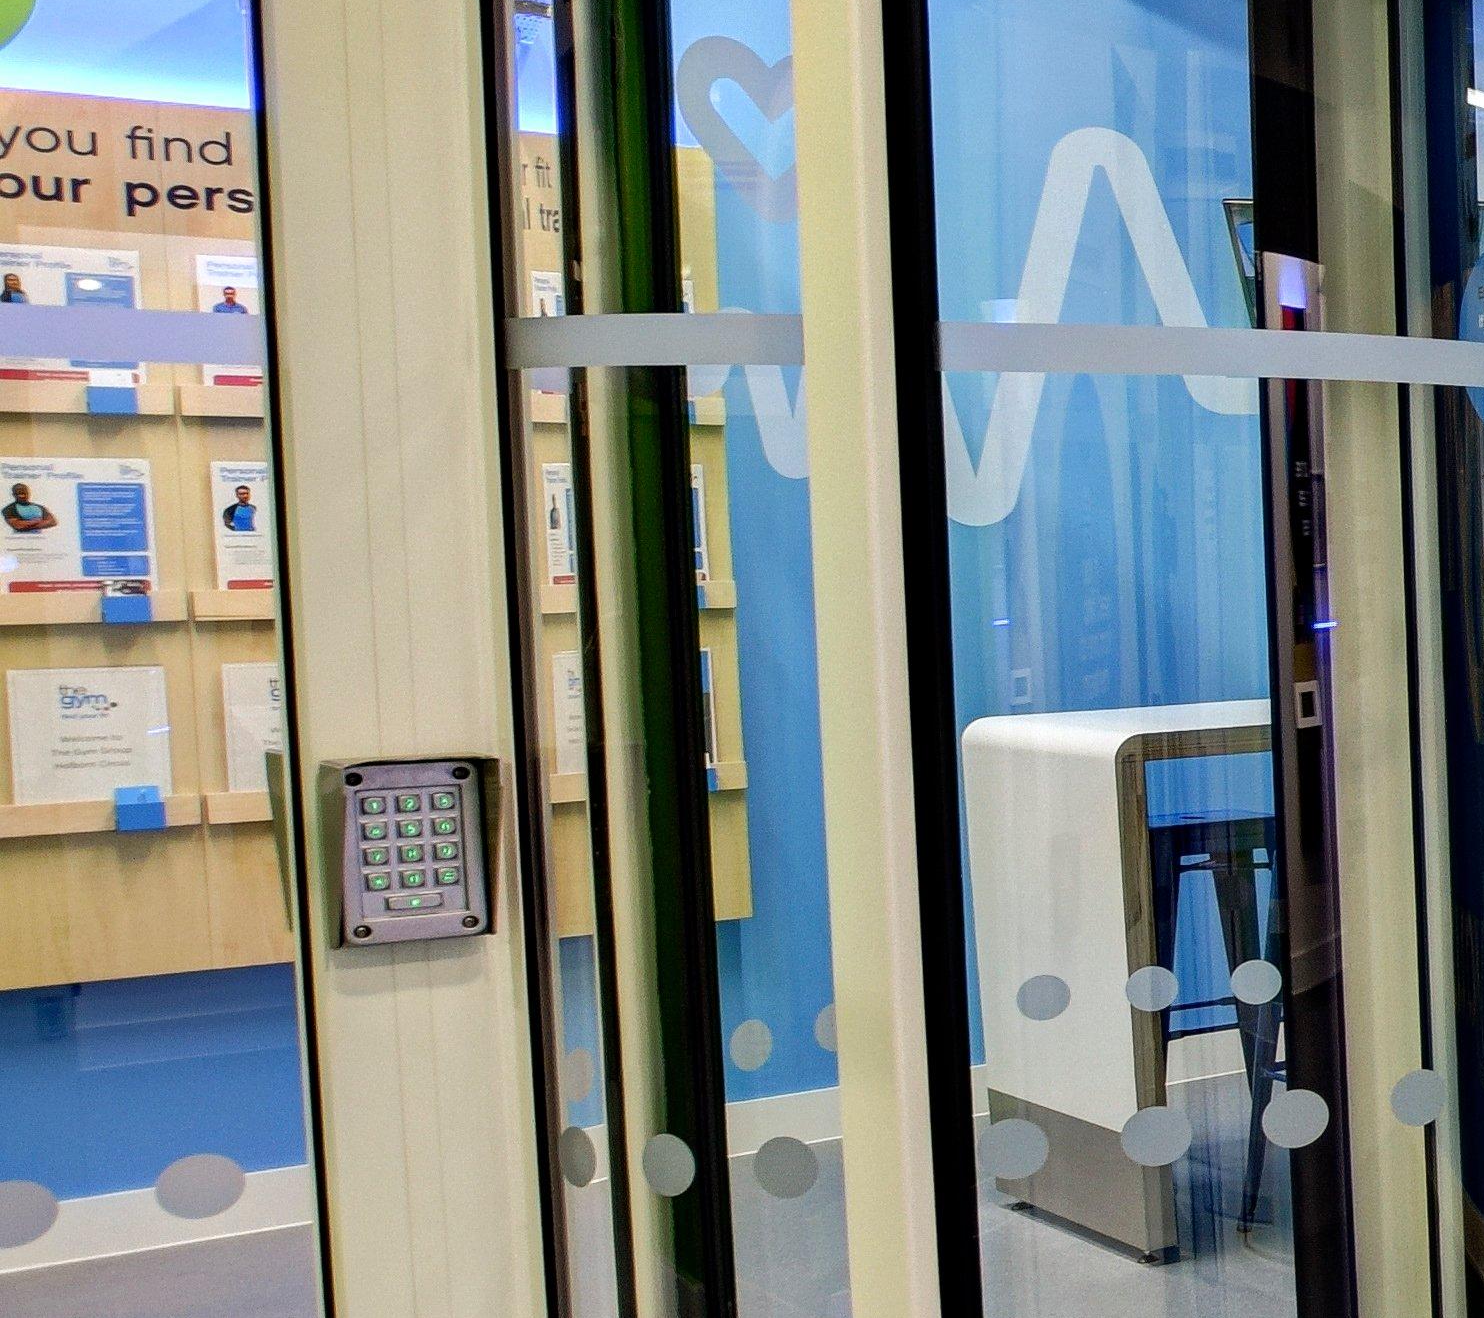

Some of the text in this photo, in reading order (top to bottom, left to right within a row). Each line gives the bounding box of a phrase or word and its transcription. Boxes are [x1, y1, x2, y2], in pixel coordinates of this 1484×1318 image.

[0, 125, 233, 166] you find
[60, 694, 108, 709] gym
